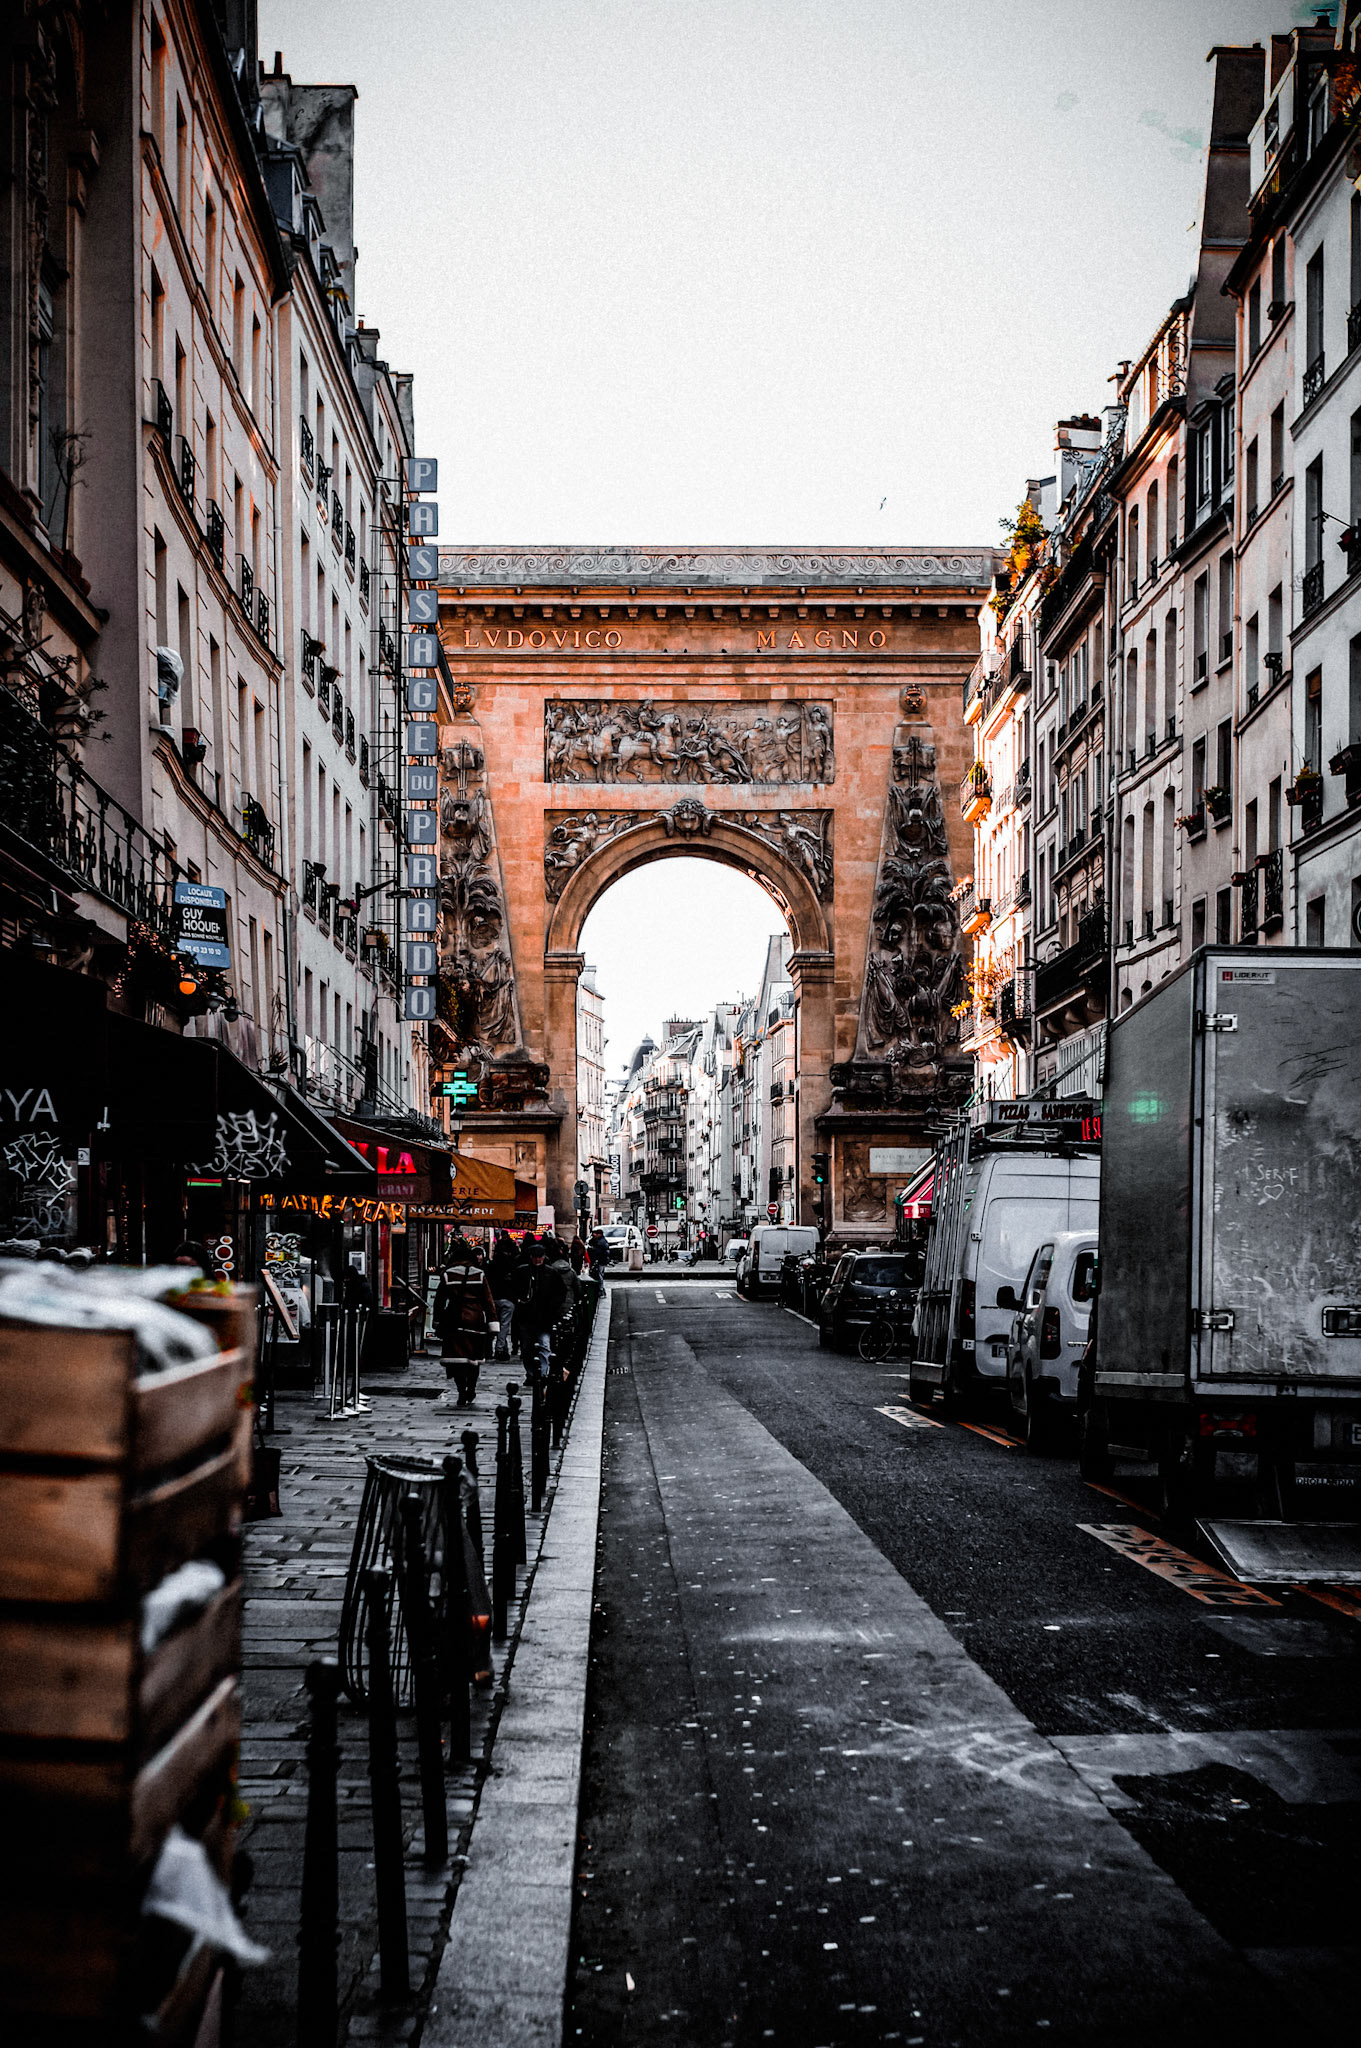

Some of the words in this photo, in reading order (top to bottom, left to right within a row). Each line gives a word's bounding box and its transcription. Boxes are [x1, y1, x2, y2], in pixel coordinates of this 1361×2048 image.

[413, 461, 433, 752] PASSAGE
[463, 629, 623, 648] LVDOVICO
[756, 630, 887, 648] MAGNO
[410, 775, 434, 791] DU
[187, 887, 213, 898] LOCAUX
[180, 895, 220, 907] DISPONIBLES
[182, 907, 203, 920] GUY
[410, 813, 432, 1017] PRADO
[999, 1104, 1030, 1120] PIZZAS
